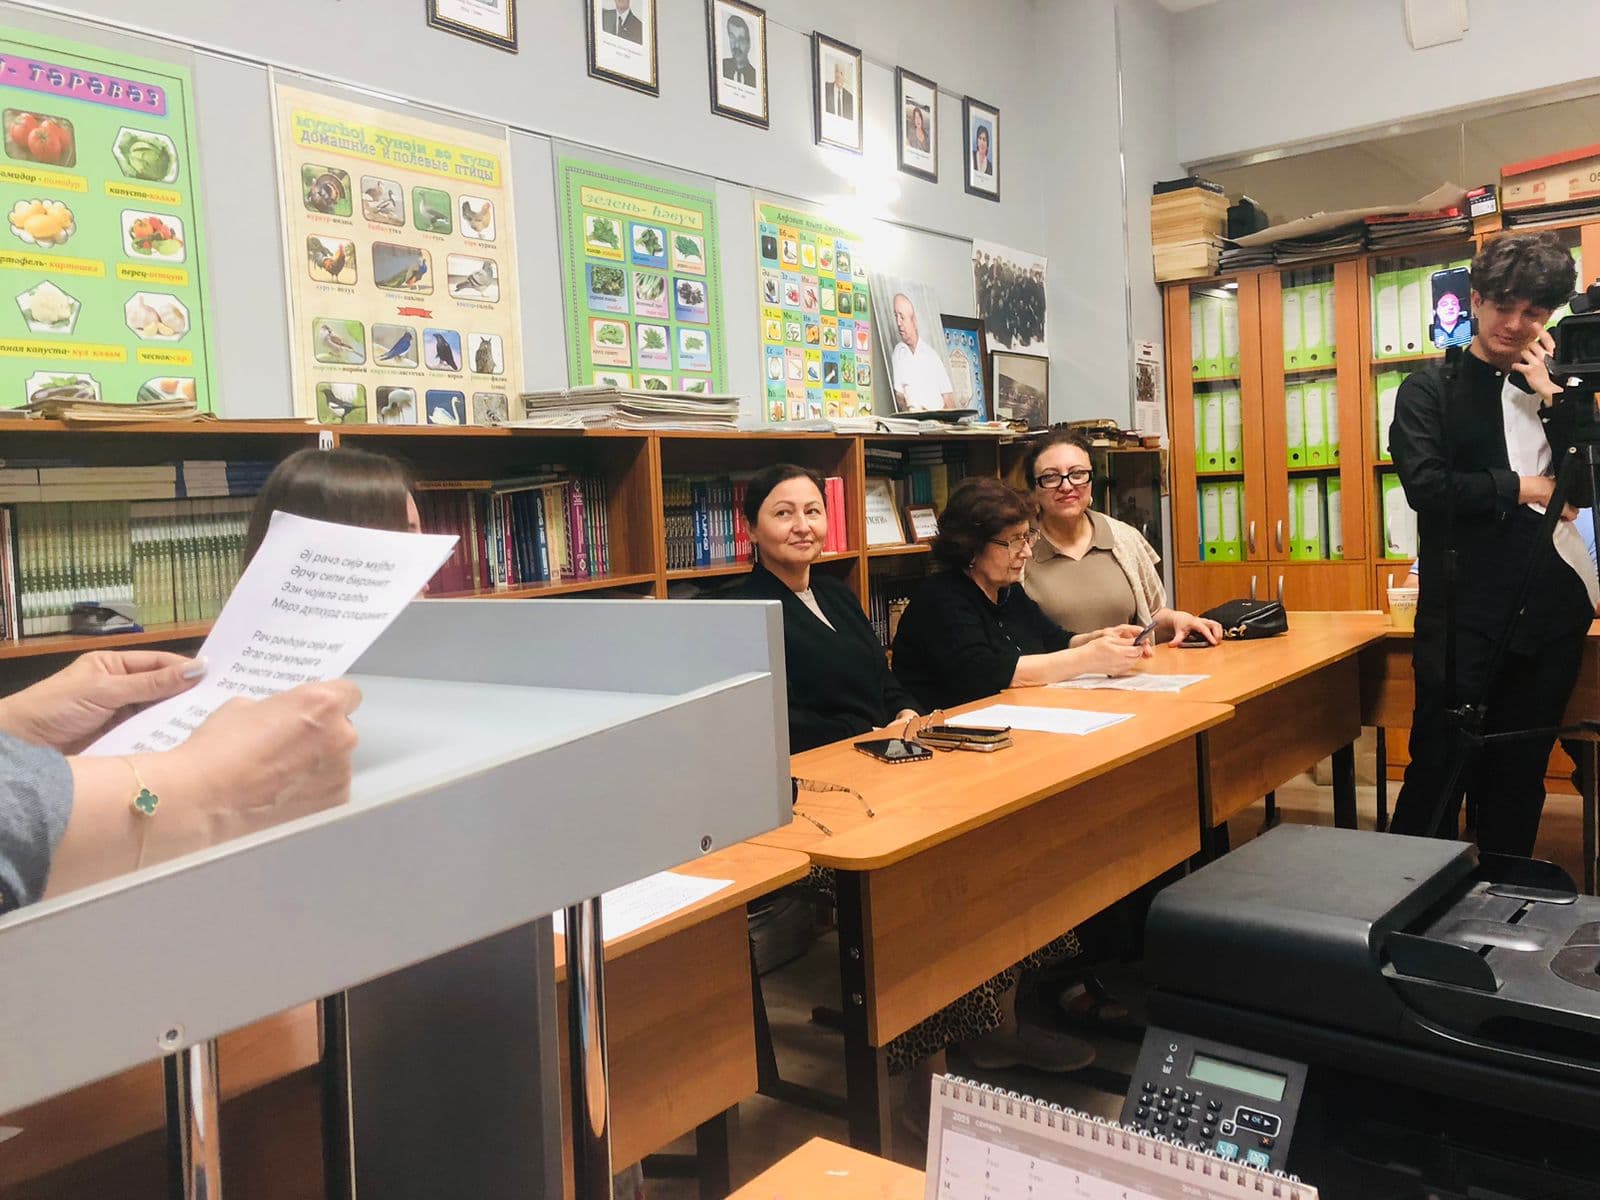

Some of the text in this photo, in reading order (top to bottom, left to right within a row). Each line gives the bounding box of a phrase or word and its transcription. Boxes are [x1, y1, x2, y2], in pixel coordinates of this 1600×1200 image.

[301, 130, 376, 156] домашние
[393, 150, 450, 172] полевые
[454, 163, 494, 182] птицы
